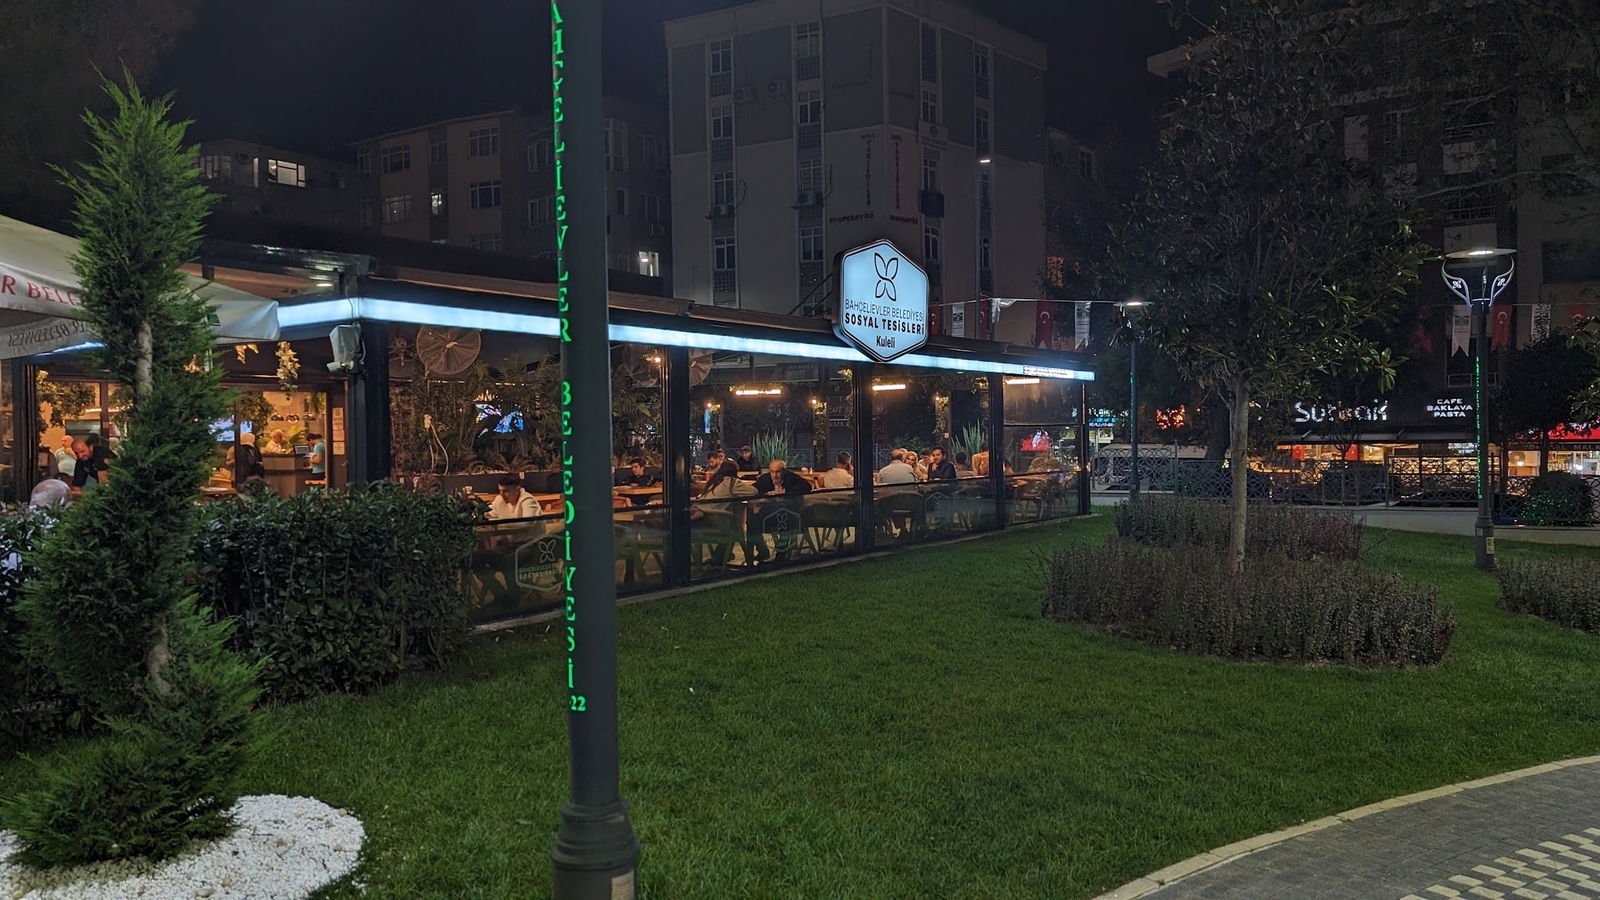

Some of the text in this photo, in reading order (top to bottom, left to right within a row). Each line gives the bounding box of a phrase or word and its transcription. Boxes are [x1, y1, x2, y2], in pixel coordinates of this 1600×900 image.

[845, 312, 925, 335] SOSYAL TESİSLERİ
[876, 335, 896, 349] Kuleli
[1426, 404, 1473, 412] BAKLAVA
